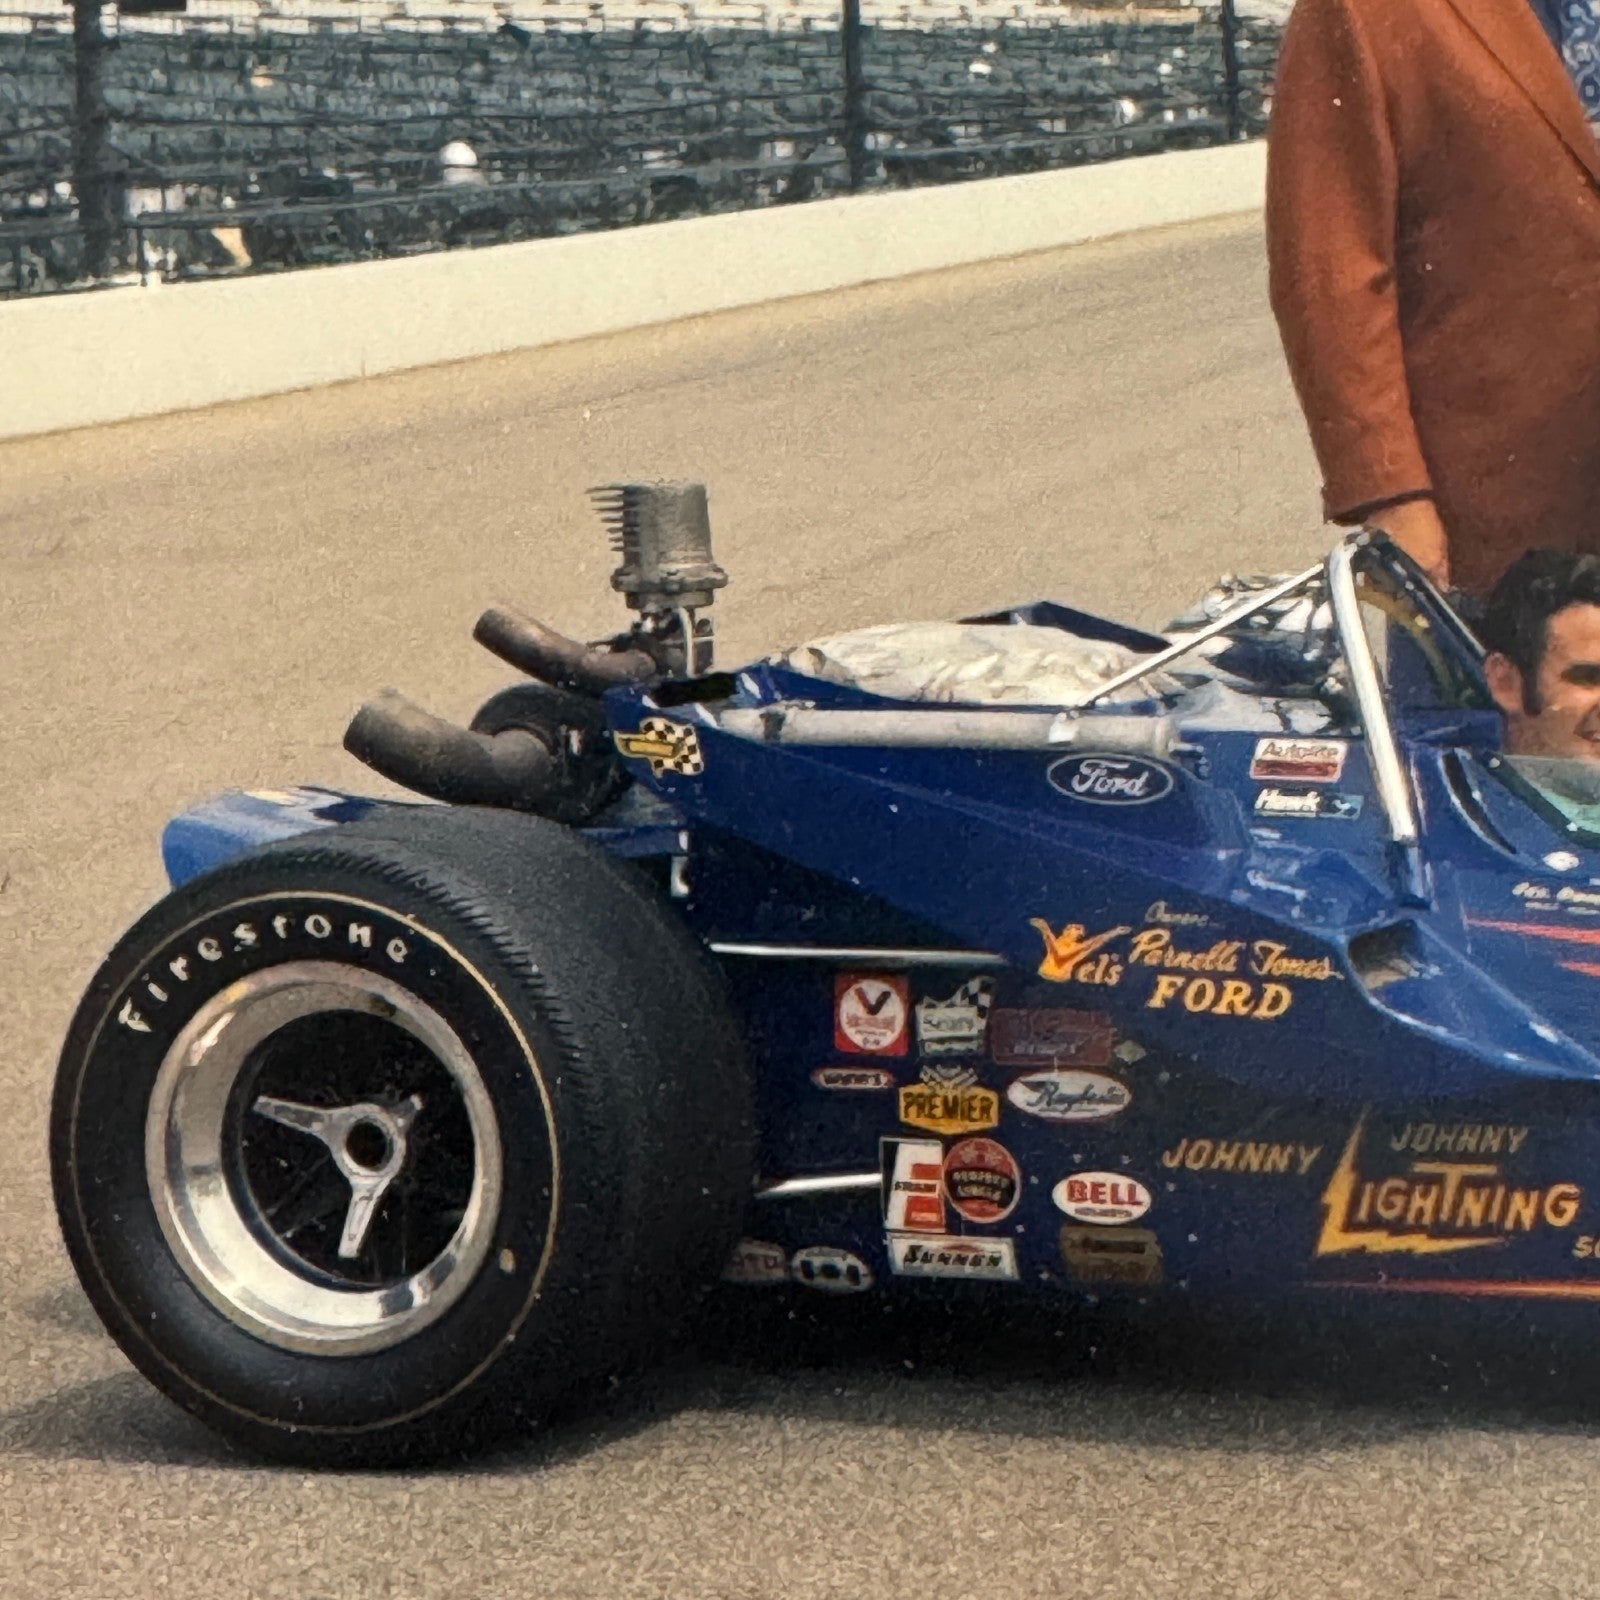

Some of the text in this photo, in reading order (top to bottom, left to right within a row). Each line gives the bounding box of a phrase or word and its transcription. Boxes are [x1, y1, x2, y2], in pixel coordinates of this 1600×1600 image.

[1071, 759, 1150, 797] Ford
[117, 913, 409, 1033] Firestone
[1145, 974, 1293, 1020] FORD
[903, 1091, 997, 1123] PREMIER
[1162, 1138, 1325, 1174] JOHNNY
[1390, 1122, 1530, 1154] JOHNNY
[1066, 1179, 1144, 1206] BELL
[1317, 1104, 1583, 1257] LIGHTNING
